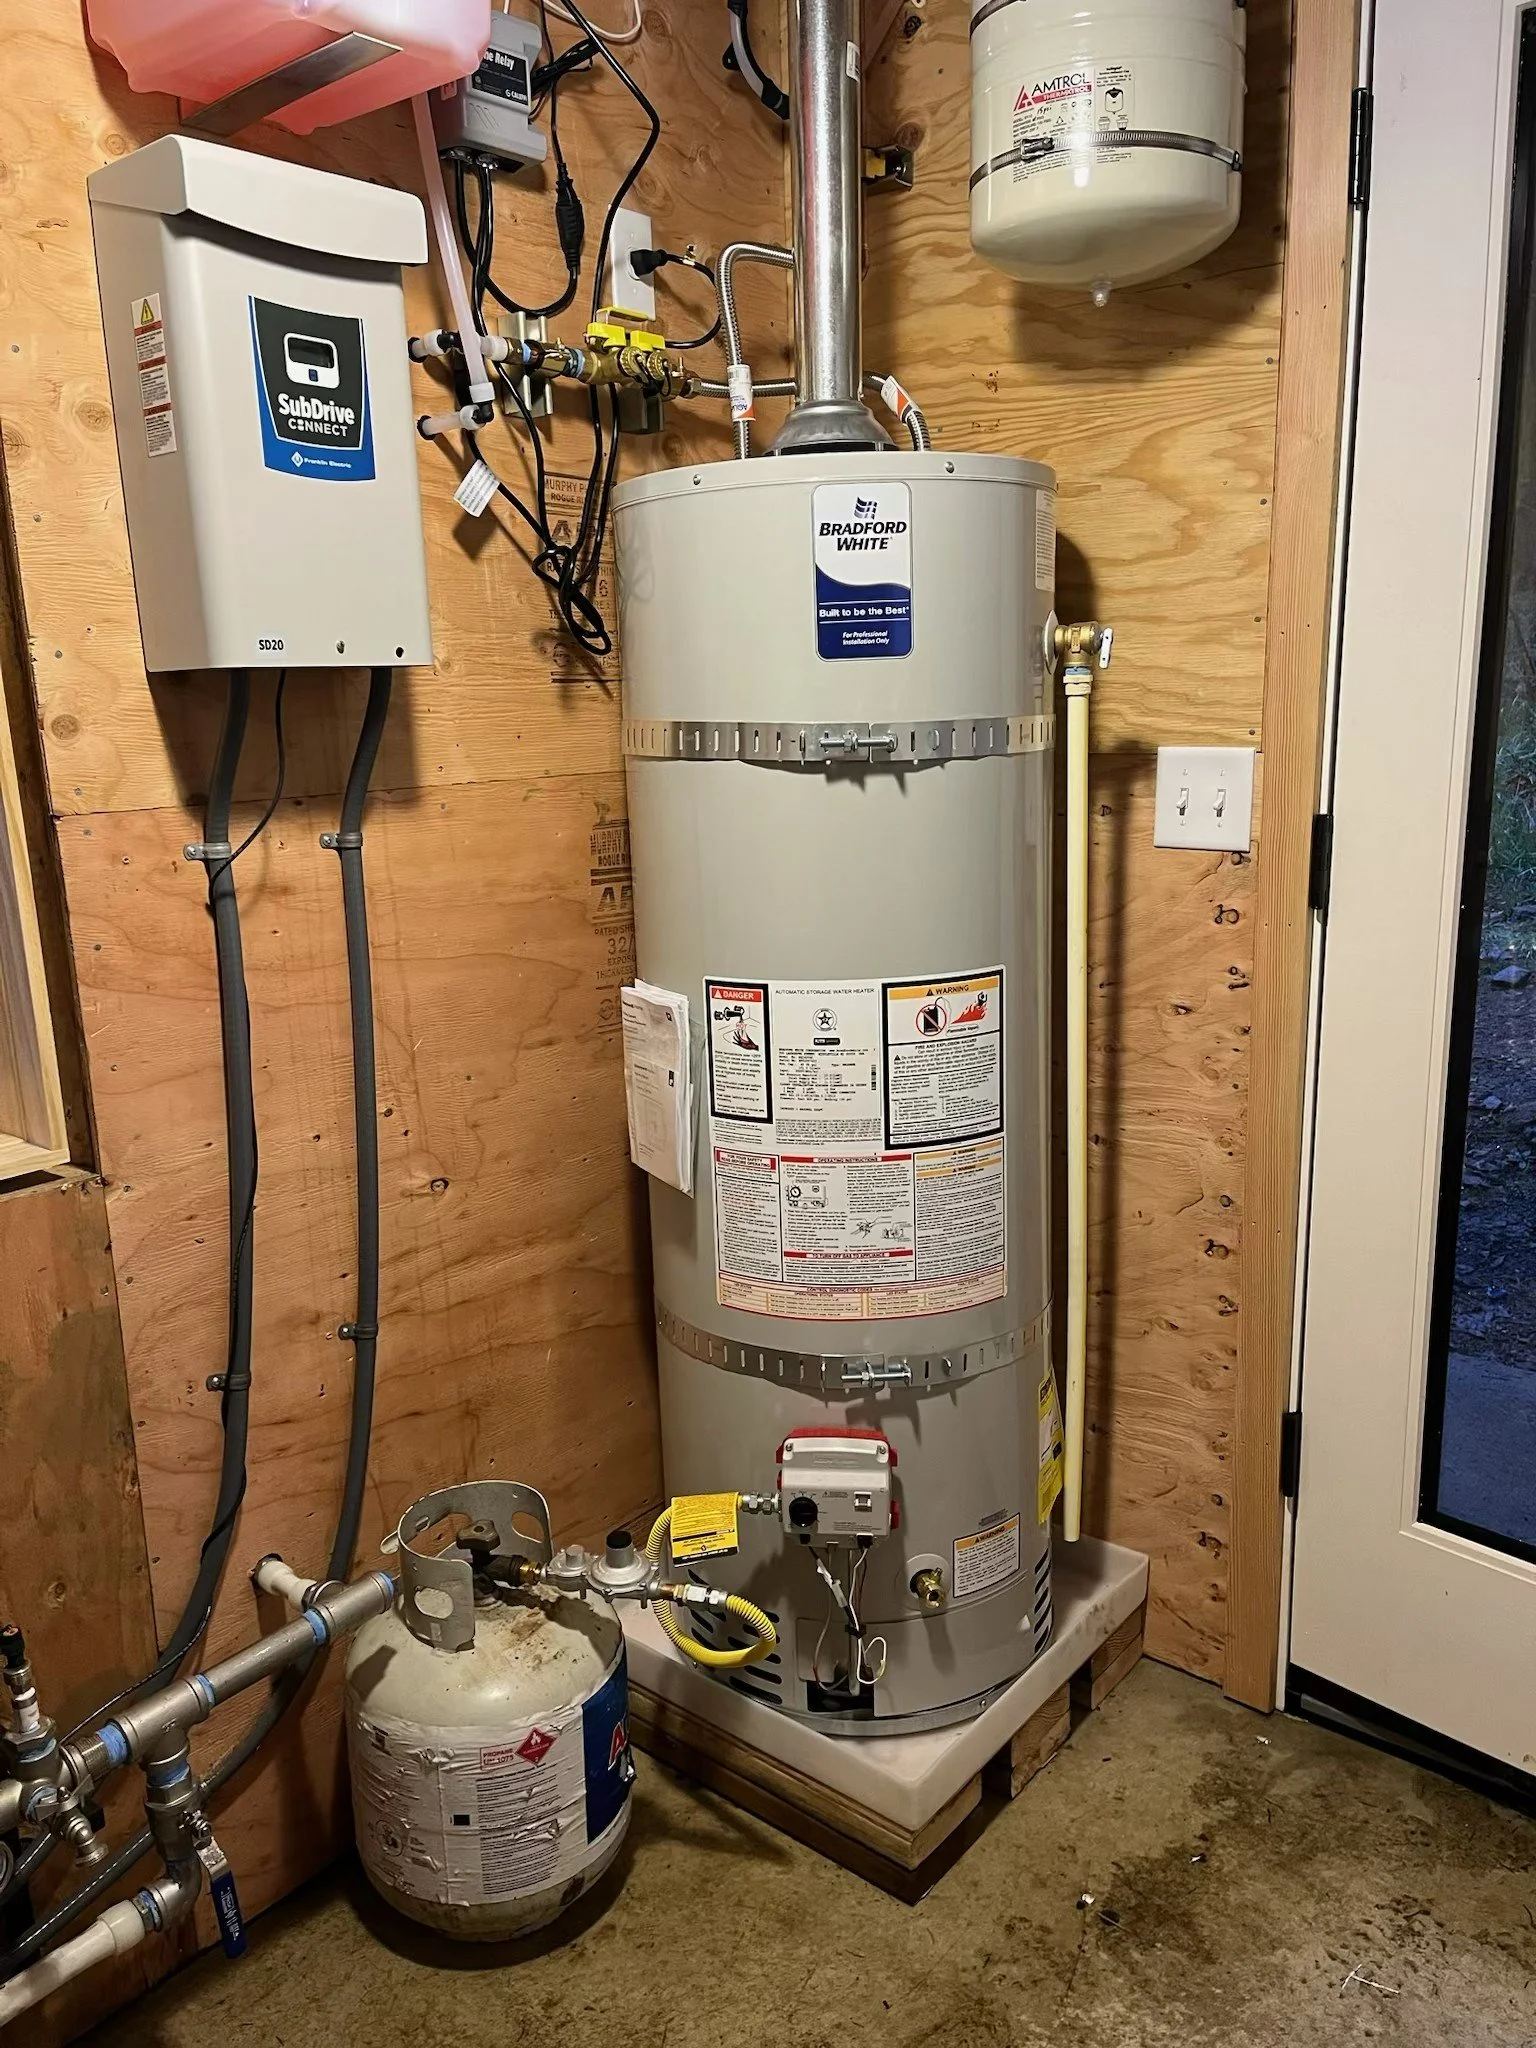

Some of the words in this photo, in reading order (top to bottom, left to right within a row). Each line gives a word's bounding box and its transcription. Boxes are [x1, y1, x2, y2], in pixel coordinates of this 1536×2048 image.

[484, 51, 494, 61] ne
[495, 53, 515, 70] Relay
[1032, 73, 1091, 96] AMTROL
[278, 393, 355, 425] SubDrive
[288, 418, 349, 437] CONNECT
[304, 457, 328, 466] Franklin
[328, 460, 352, 469] Electric
[550, 493, 575, 504] ROGUE
[819, 521, 907, 537] BRADFORD
[836, 537, 889, 551] WHITE
[819, 609, 840, 618] Built
[842, 609, 851, 617] to
[853, 608, 866, 616] be
[868, 607, 883, 616] the
[853, 630, 888, 638] Professional
[259, 639, 284, 651] SD20
[842, 638, 876, 646] Installation
[876, 637, 890, 645] Only
[723, 990, 754, 1000] DANGER
[936, 984, 969, 995] WARNING
[483, 1748, 513, 1758] PROPANE
[498, 1755, 514, 1763] 1075
